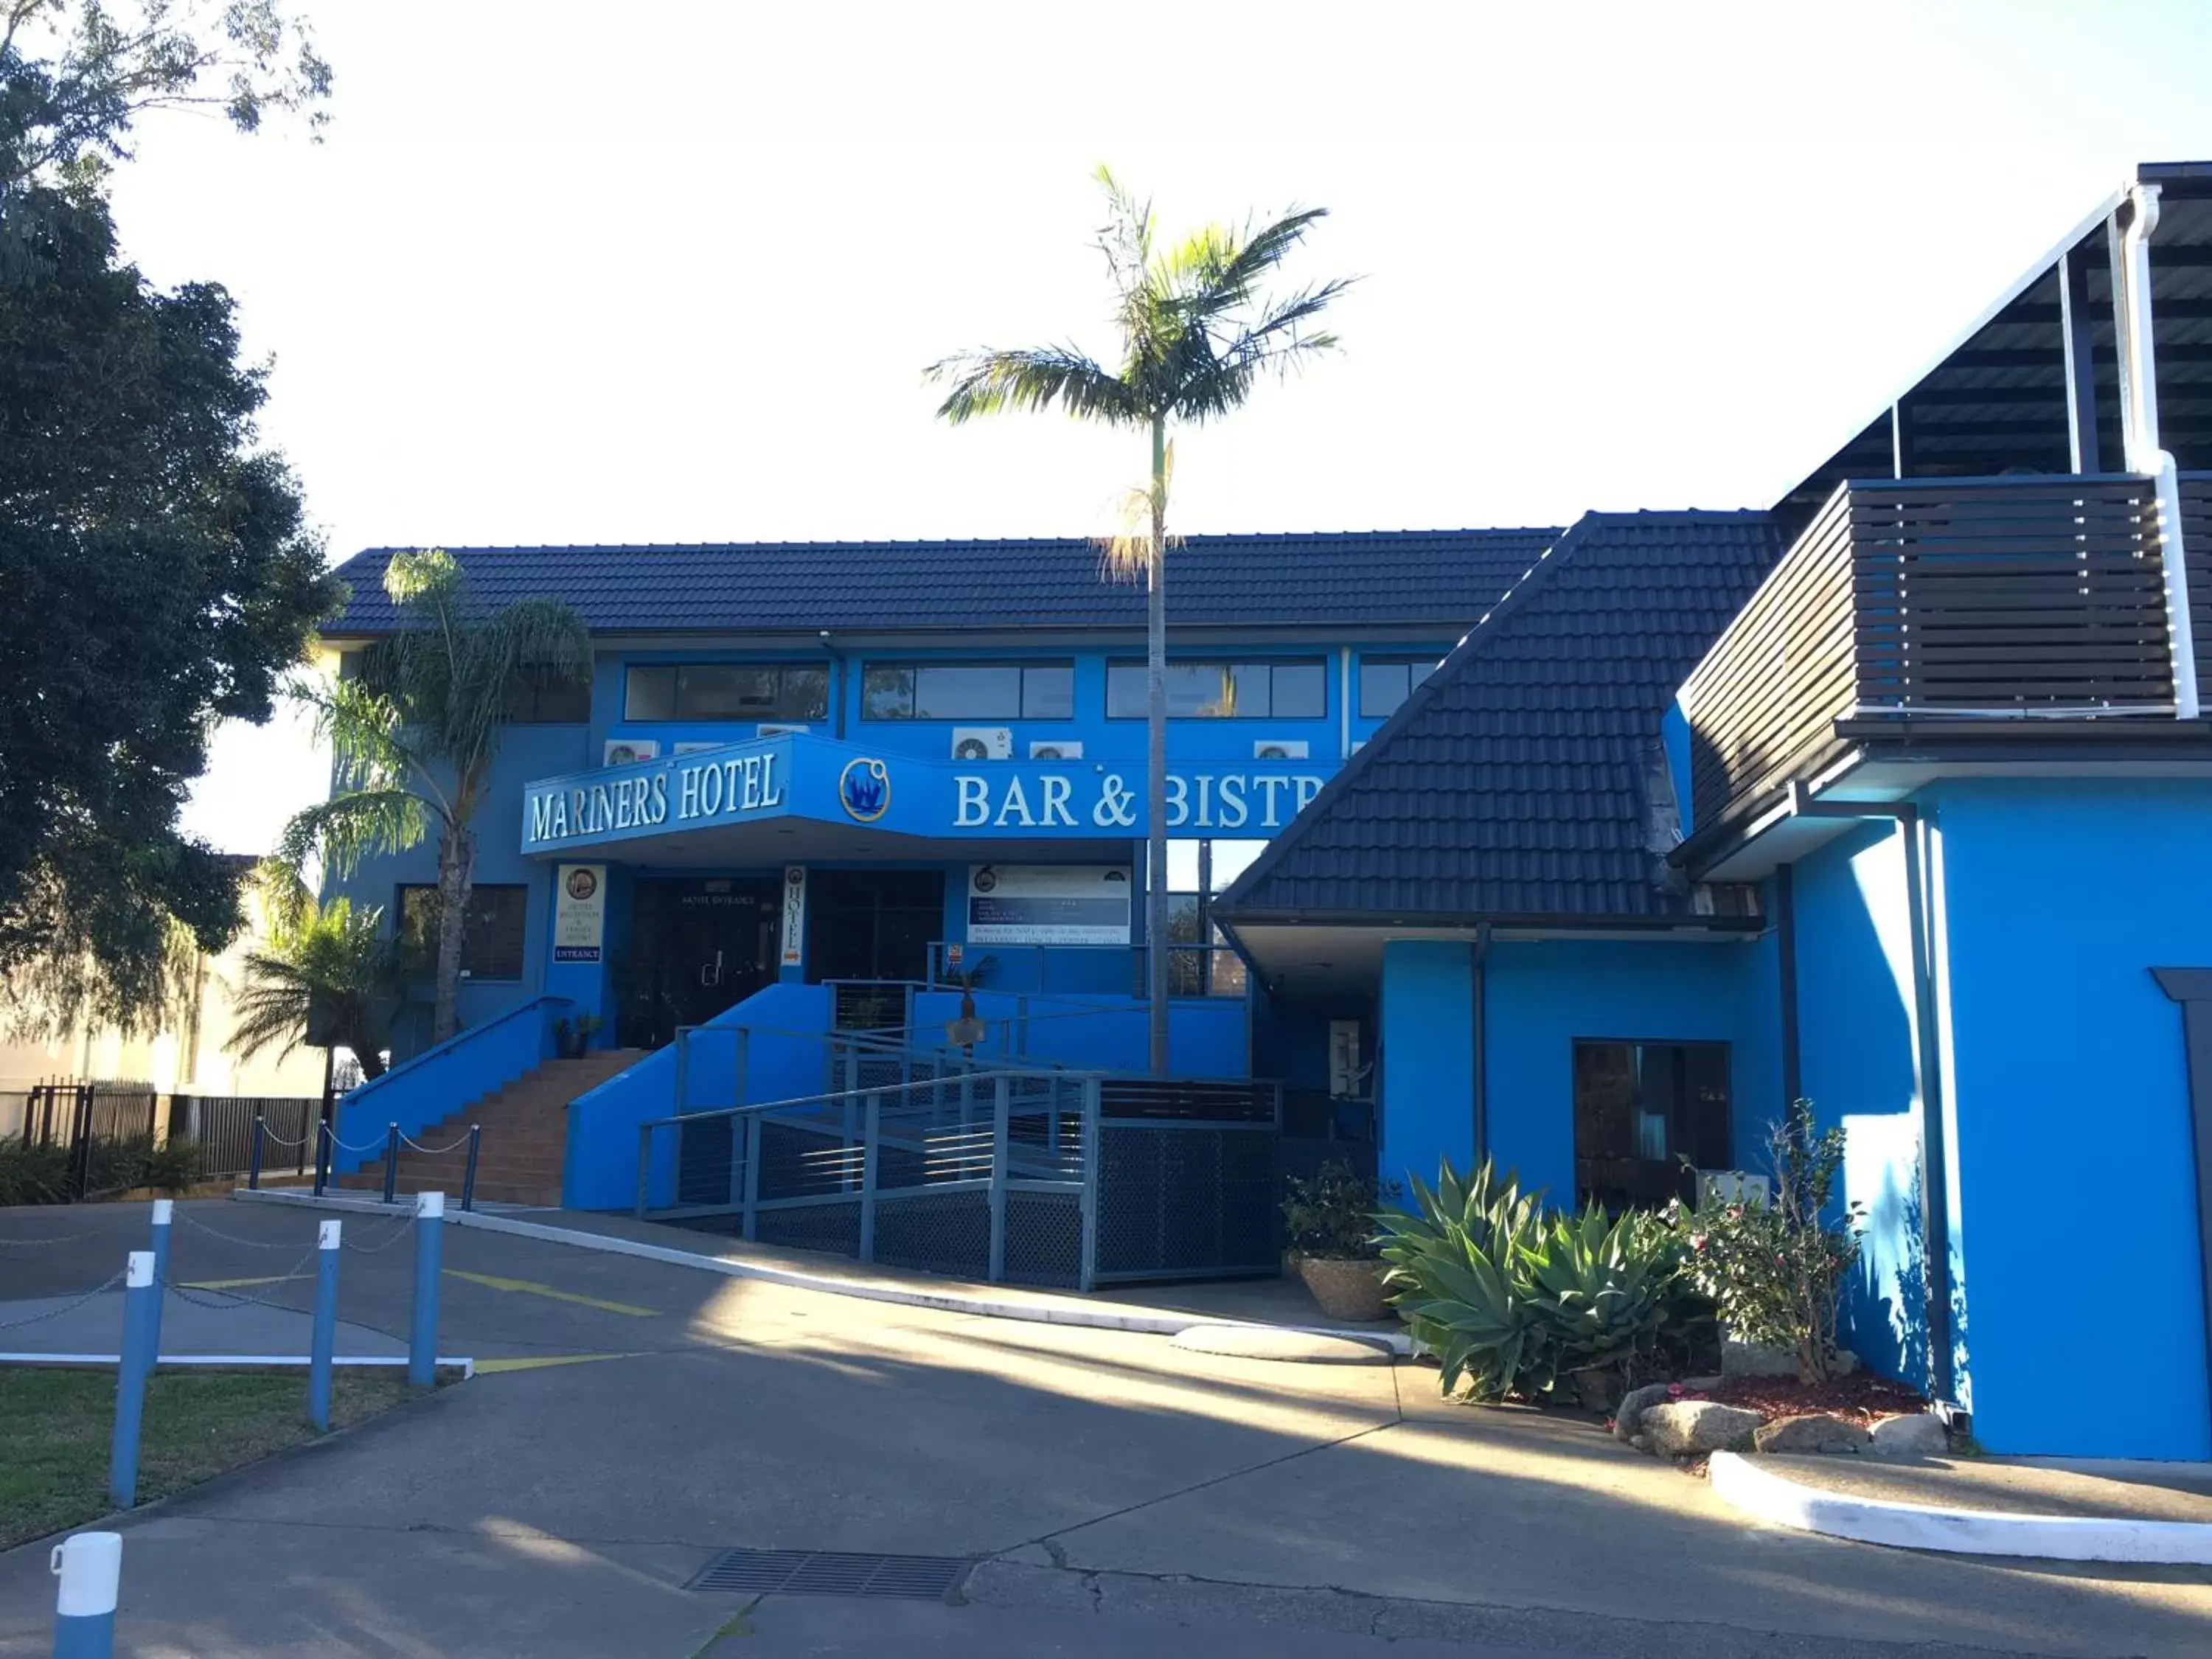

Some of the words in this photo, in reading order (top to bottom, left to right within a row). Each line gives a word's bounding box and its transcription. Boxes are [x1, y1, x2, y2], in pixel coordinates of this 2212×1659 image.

[529, 773, 667, 842] MARINERS
[678, 754, 780, 819] HOTEL
[953, 774, 1079, 827] BAR
[1093, 773, 1136, 827] &
[557, 949, 599, 959] ENTRANCE
